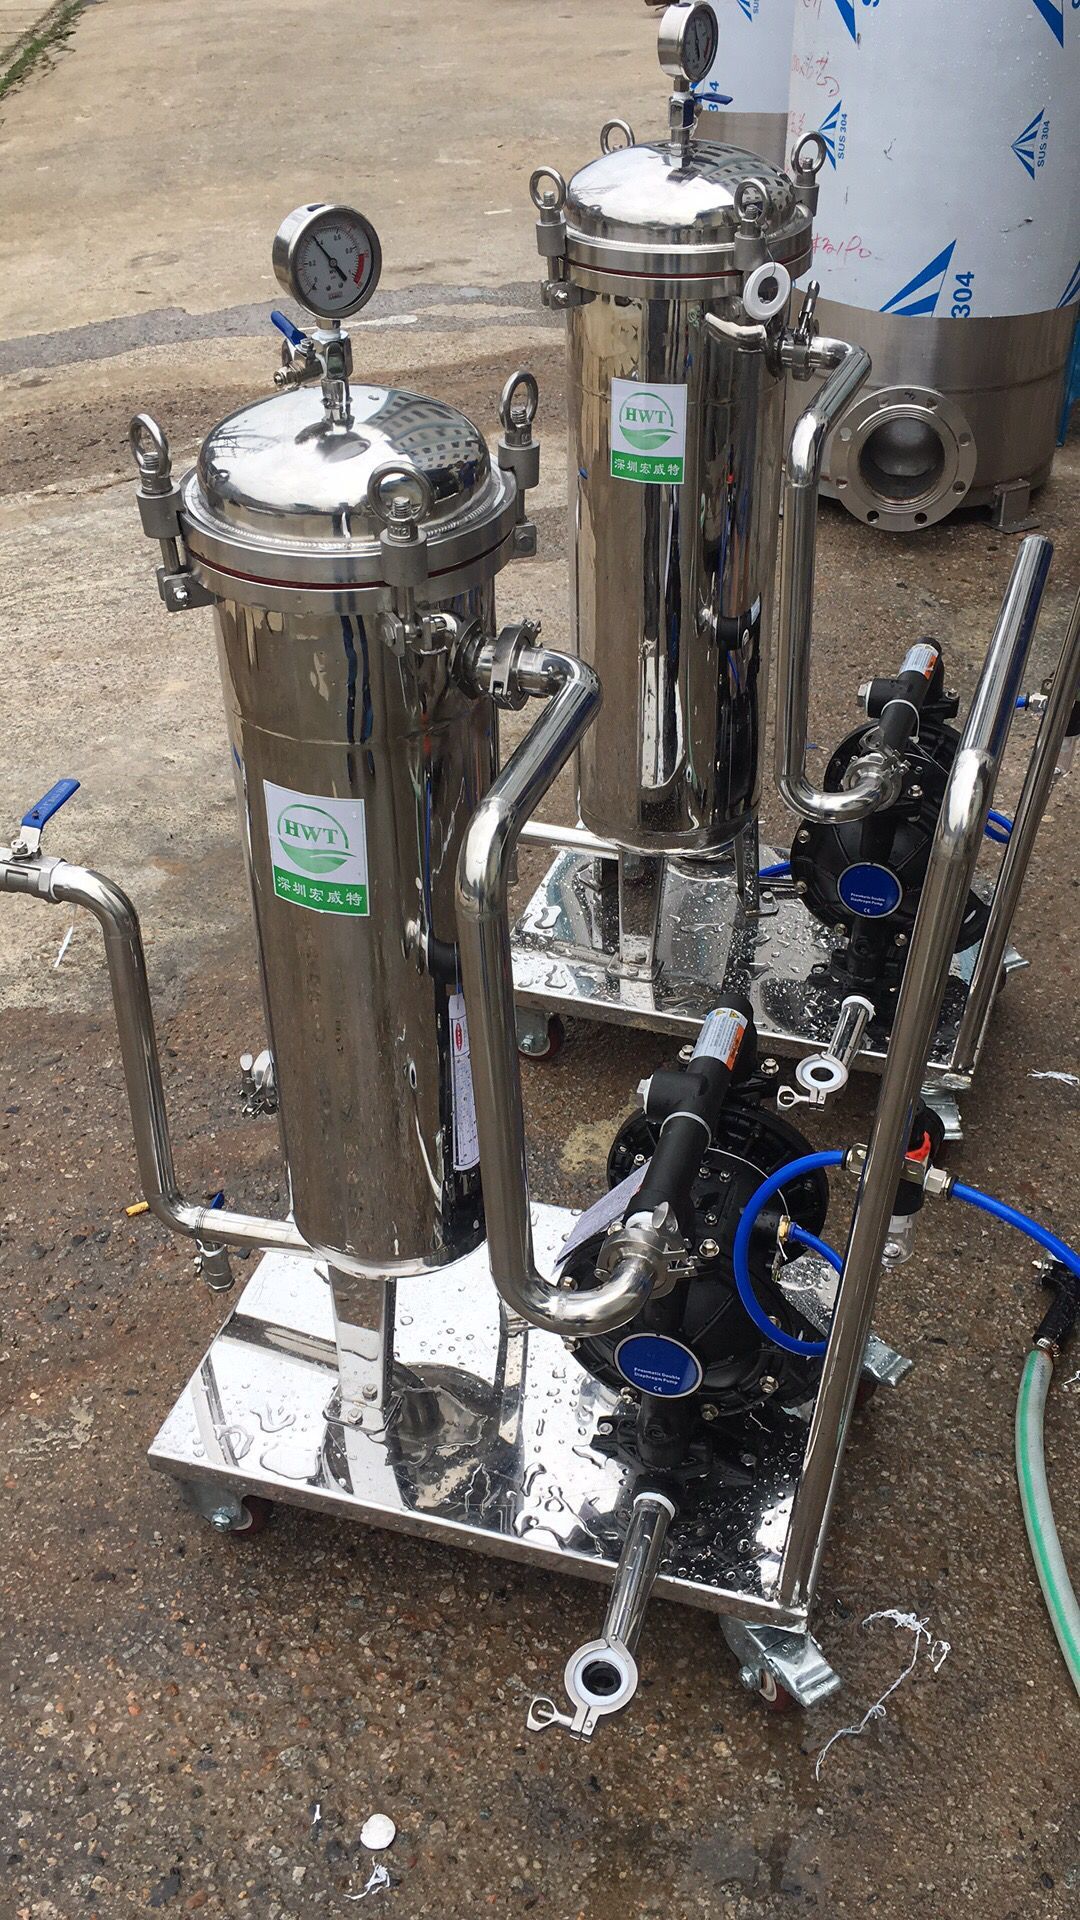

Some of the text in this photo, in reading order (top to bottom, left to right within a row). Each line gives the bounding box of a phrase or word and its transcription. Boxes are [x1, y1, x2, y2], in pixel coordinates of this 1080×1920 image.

[708, 81, 719, 112] 34
[838, 136, 846, 159] SUS
[1037, 120, 1050, 167] SUS 304
[951, 271, 974, 319] 304
[625, 407, 666, 424] HWT
[614, 458, 680, 476] 深圳宏威特
[284, 818, 338, 844] HWT
[277, 875, 363, 906] 深圳宏威特
[663, 1377, 678, 1385] Pump
